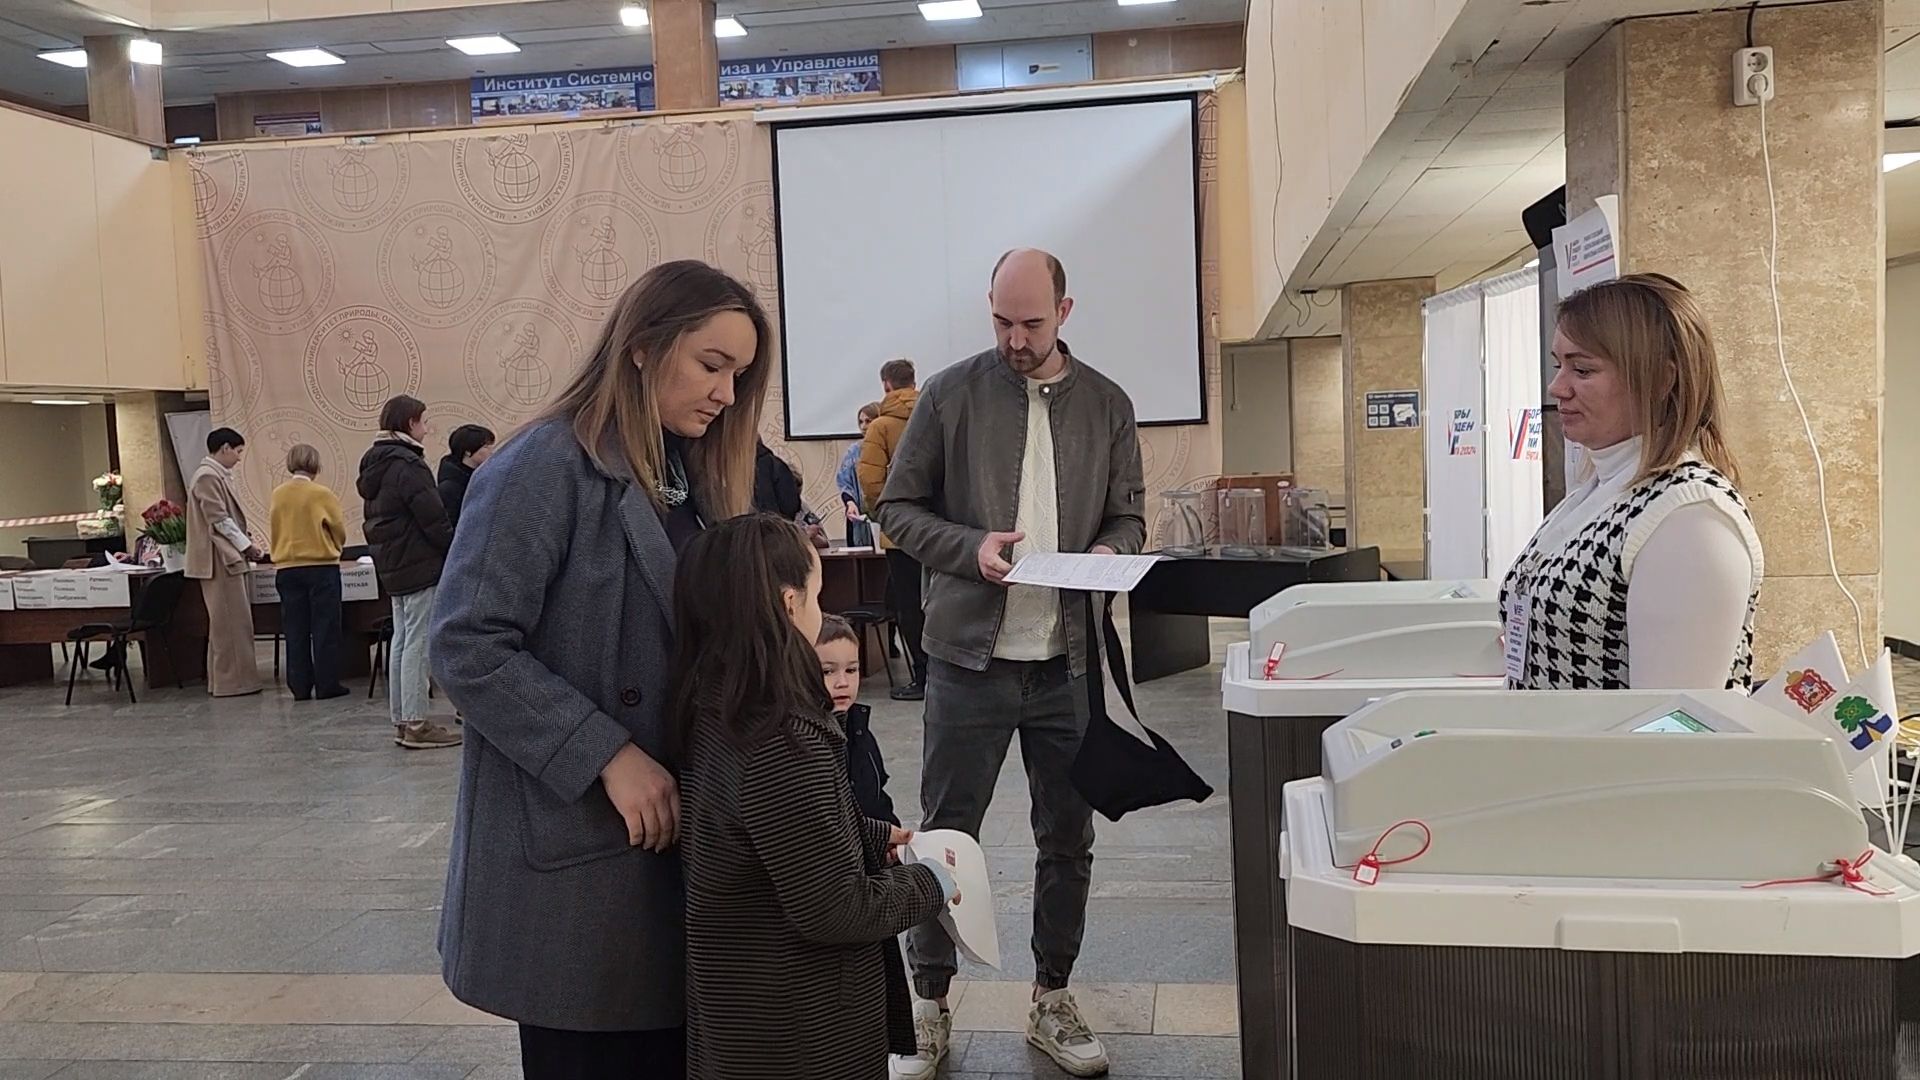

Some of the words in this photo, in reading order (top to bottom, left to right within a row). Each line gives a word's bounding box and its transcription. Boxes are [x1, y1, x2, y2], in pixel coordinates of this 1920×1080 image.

[484, 77, 562, 91] Институт
[756, 63, 766, 73] и
[771, 55, 878, 73] Управления
[554, 150, 570, 197] ЧЕЛОВЕКА
[307, 316, 338, 367] УНИВЕРСИТЕТ
[382, 314, 414, 352] ОБЩЕСТВА
[307, 369, 357, 427] МЕЖДУНАРОДНЫЙ
